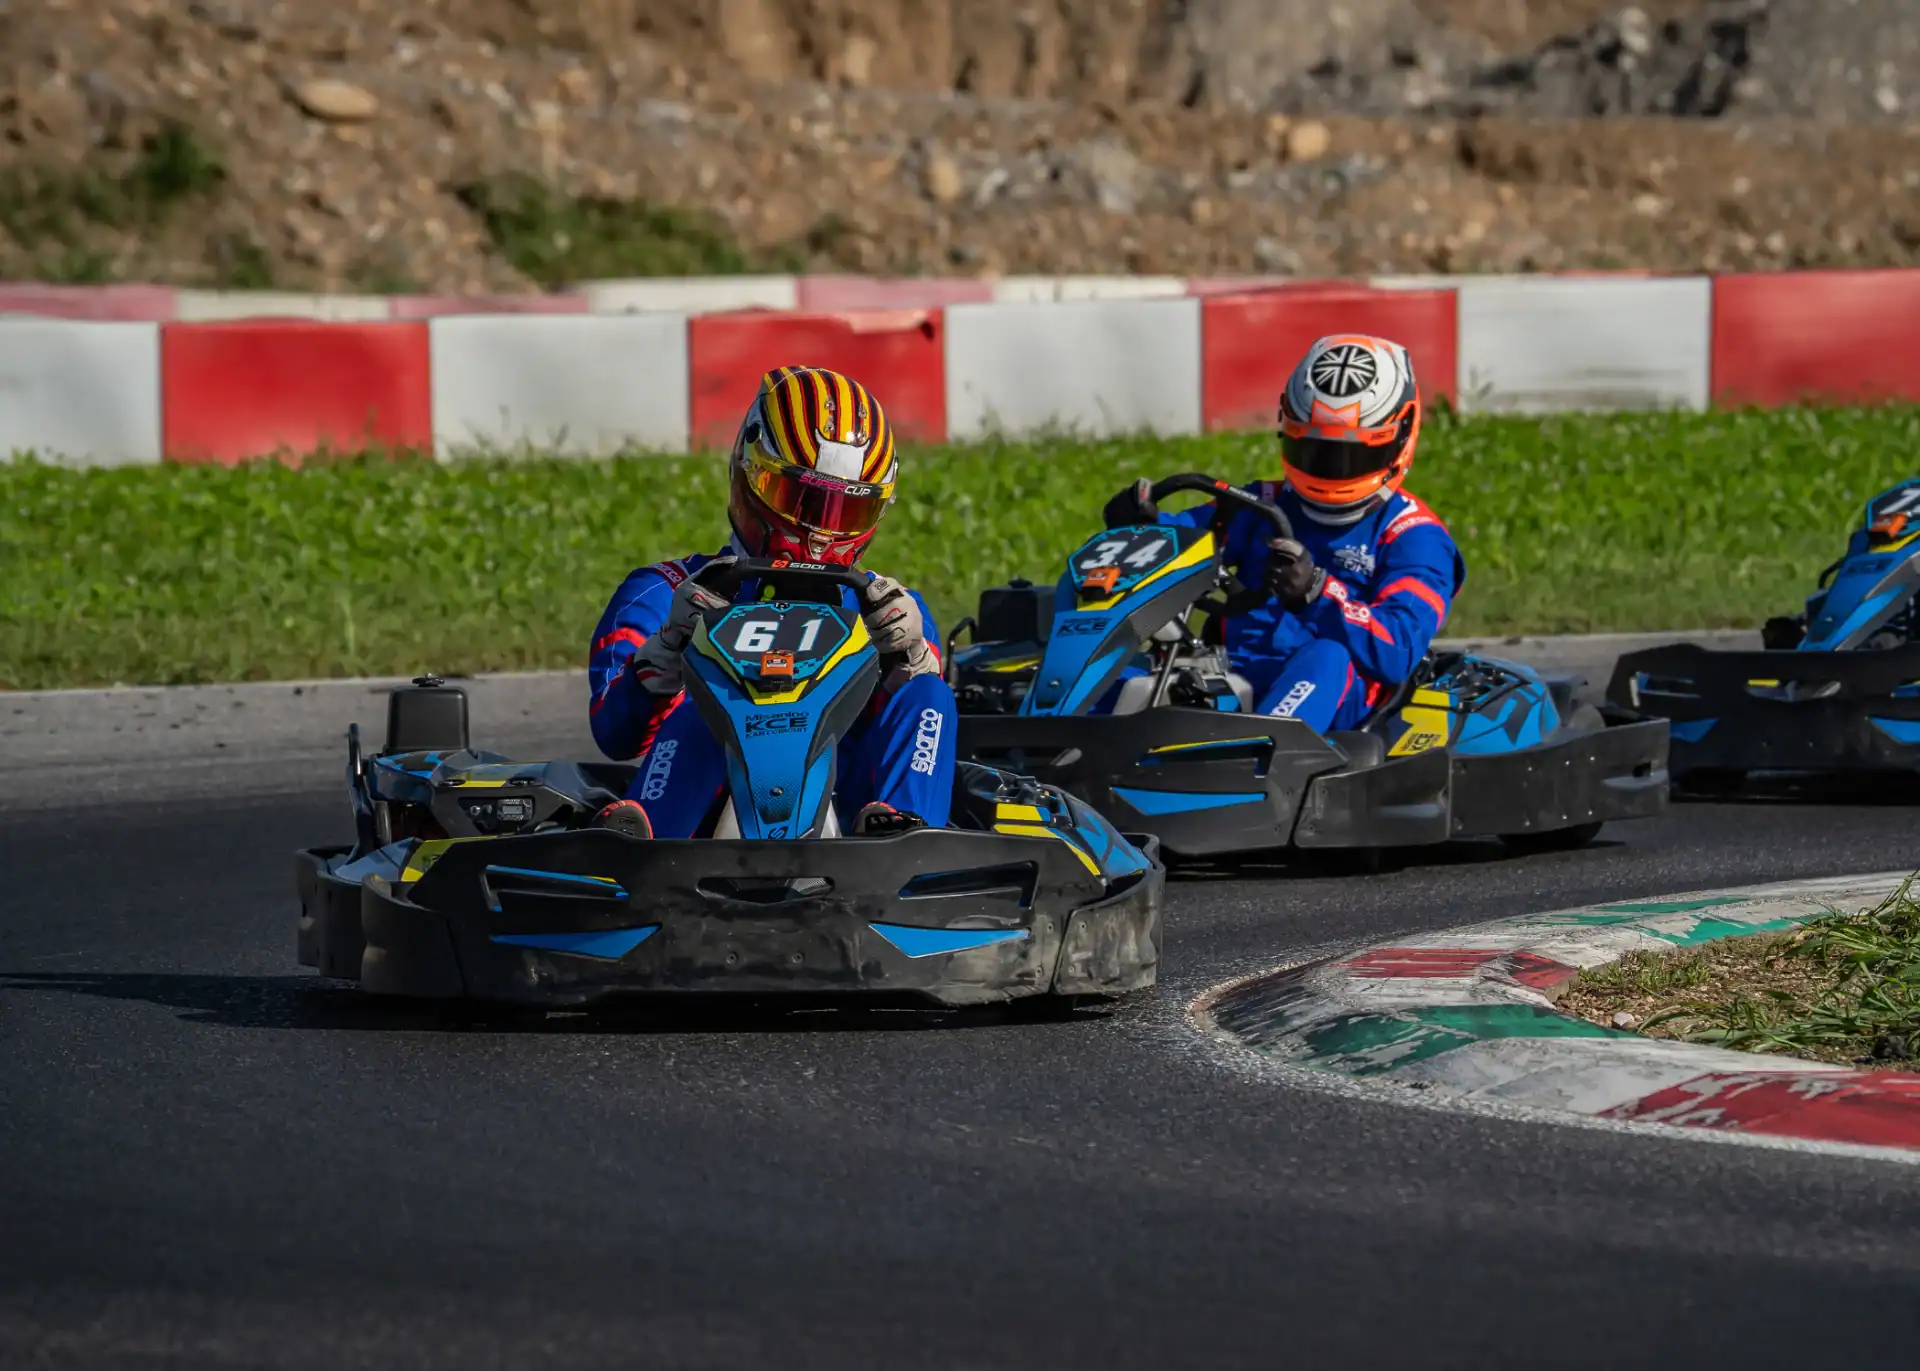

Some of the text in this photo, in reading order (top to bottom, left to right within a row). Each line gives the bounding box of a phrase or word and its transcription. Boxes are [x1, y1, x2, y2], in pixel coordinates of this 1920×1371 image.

[789, 562, 826, 571] SODI
[1269, 680, 1316, 718] parco
[745, 717, 809, 733] KCE
[911, 708, 942, 775] sparco
[641, 739, 678, 800] sparco
